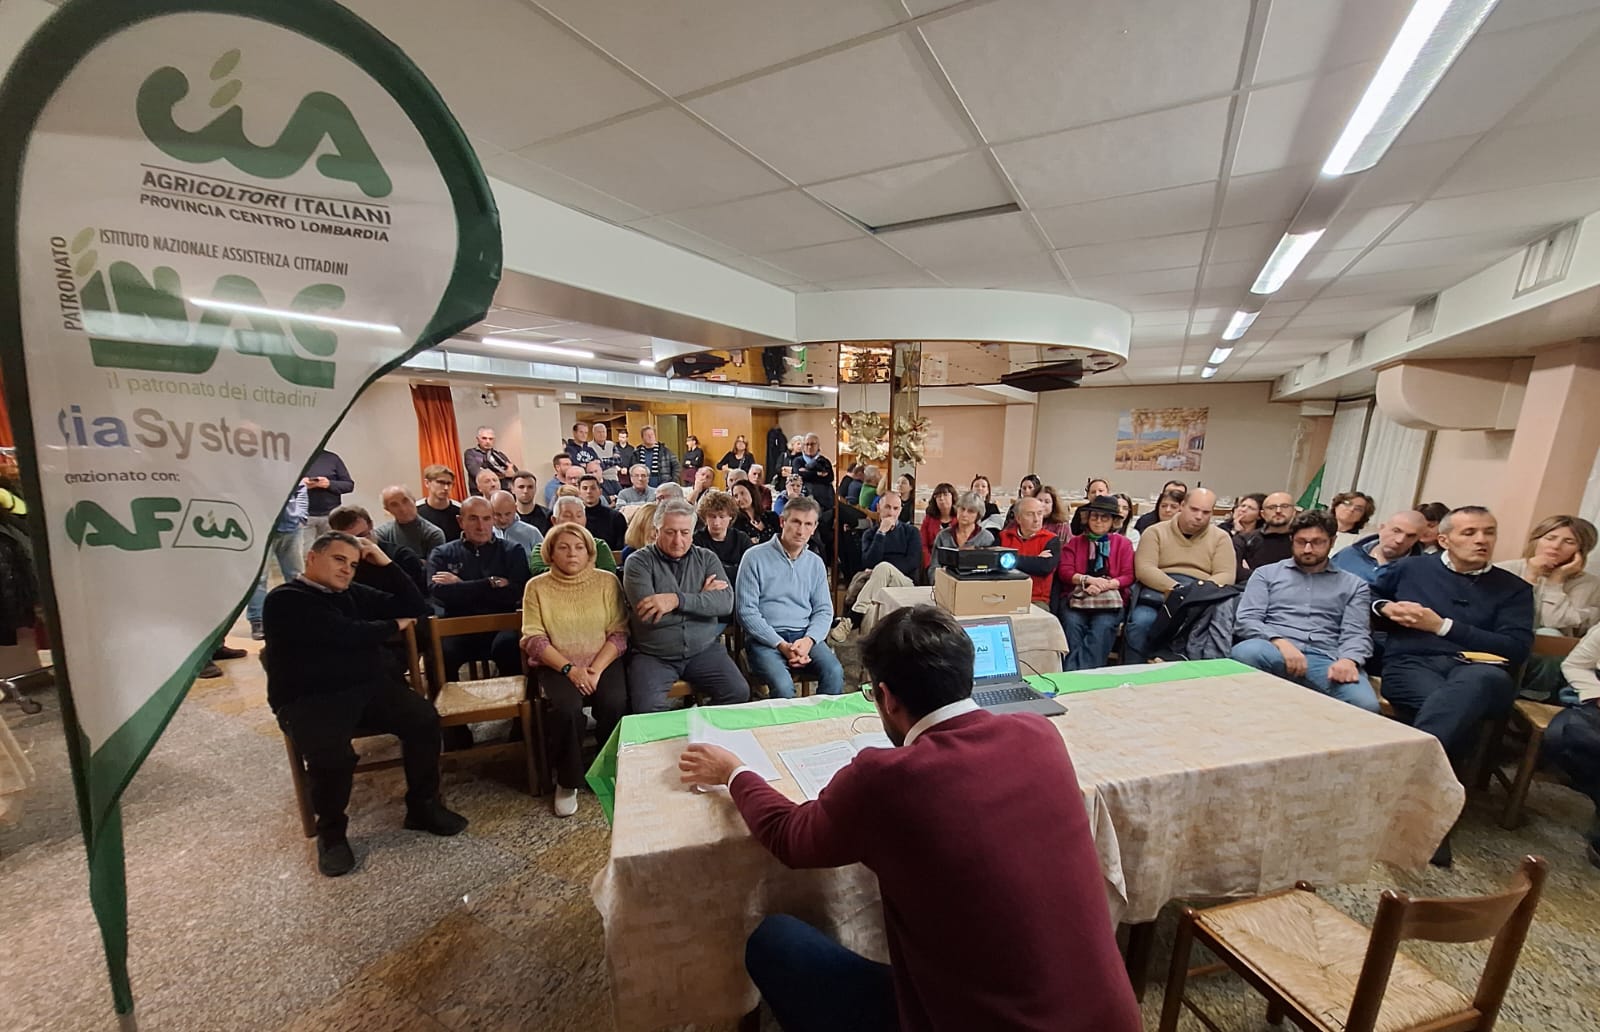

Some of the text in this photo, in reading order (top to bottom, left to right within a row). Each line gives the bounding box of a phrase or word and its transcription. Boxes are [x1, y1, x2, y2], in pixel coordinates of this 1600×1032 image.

[140, 194, 389, 242] PROVINCIA CENTRO LOMBARDIA
[142, 171, 392, 225] AGRICOLTORI ITALIANI
[100, 228, 348, 276] ISTITUTO NAZIONALE ASSISTENZA CITTADINI
[52, 236, 83, 331] PATRONATO
[106, 372, 318, 409] il patronato dei cittadini
[151, 471, 180, 483] con:
